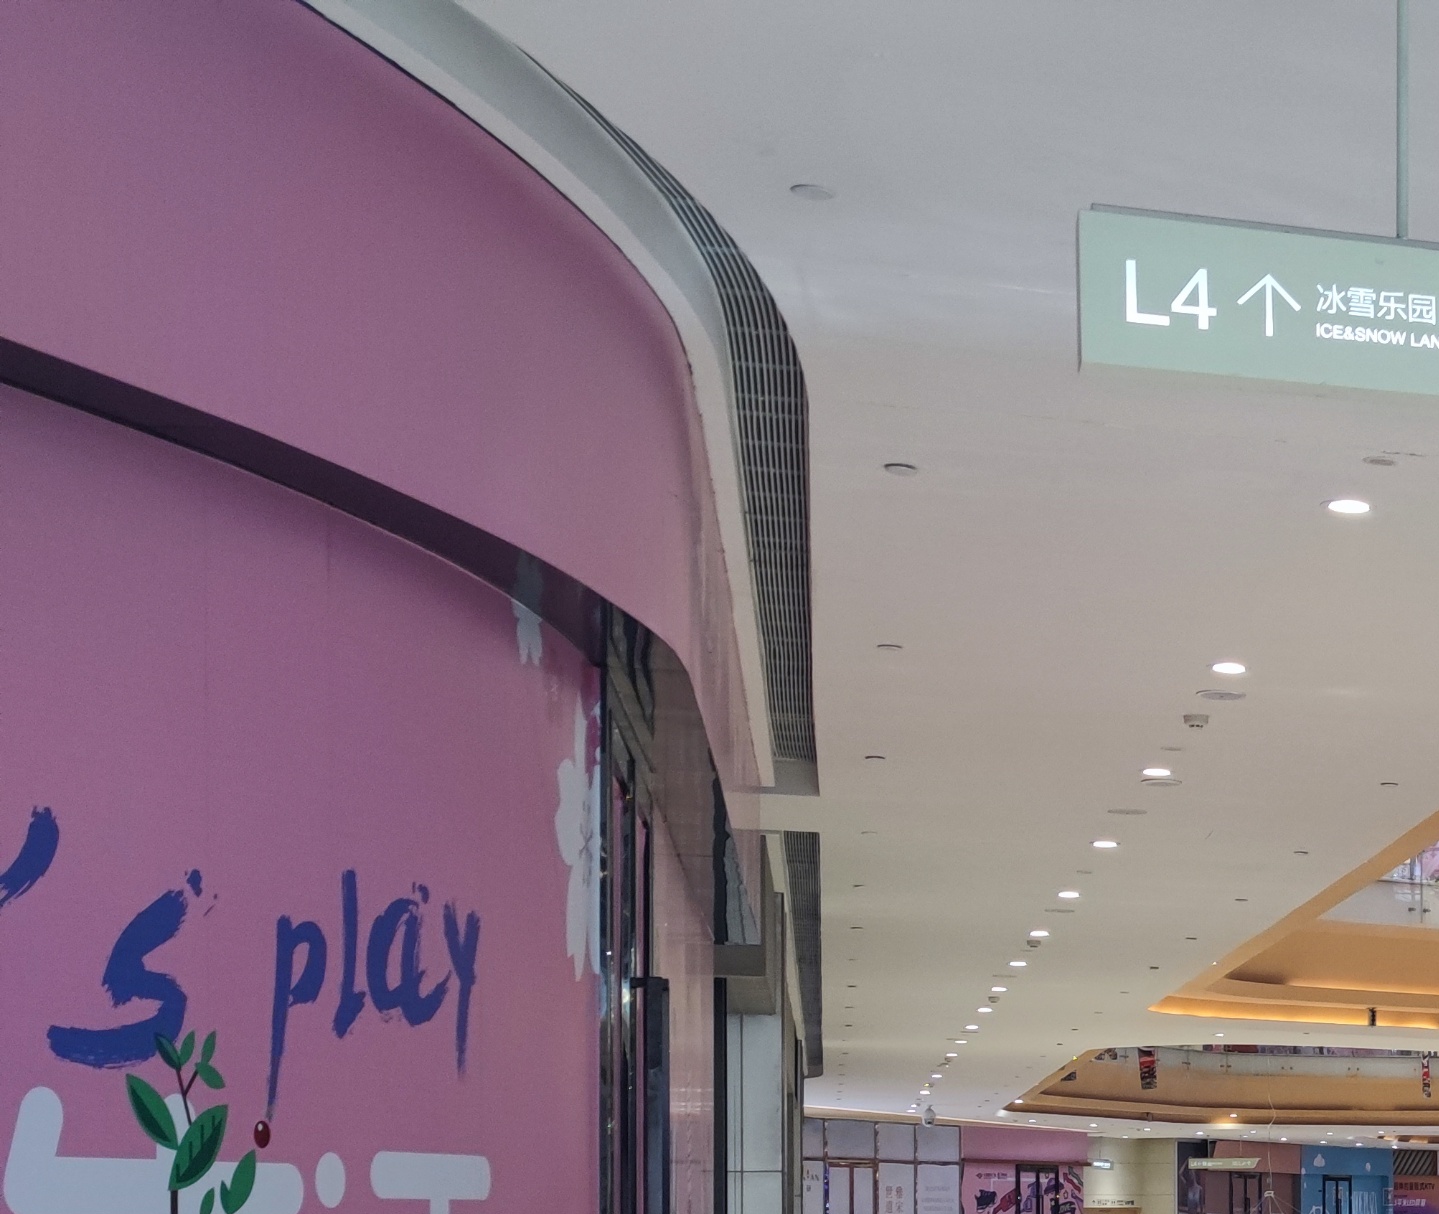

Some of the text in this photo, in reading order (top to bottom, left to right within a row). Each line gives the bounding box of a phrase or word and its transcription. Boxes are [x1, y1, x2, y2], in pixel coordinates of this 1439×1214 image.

[1124, 258, 1218, 331] L4
[1315, 282, 1438, 326] 冰雪乐园
[1314, 322, 1405, 346] ICE&SNOW
[264, 868, 482, 1122] play
